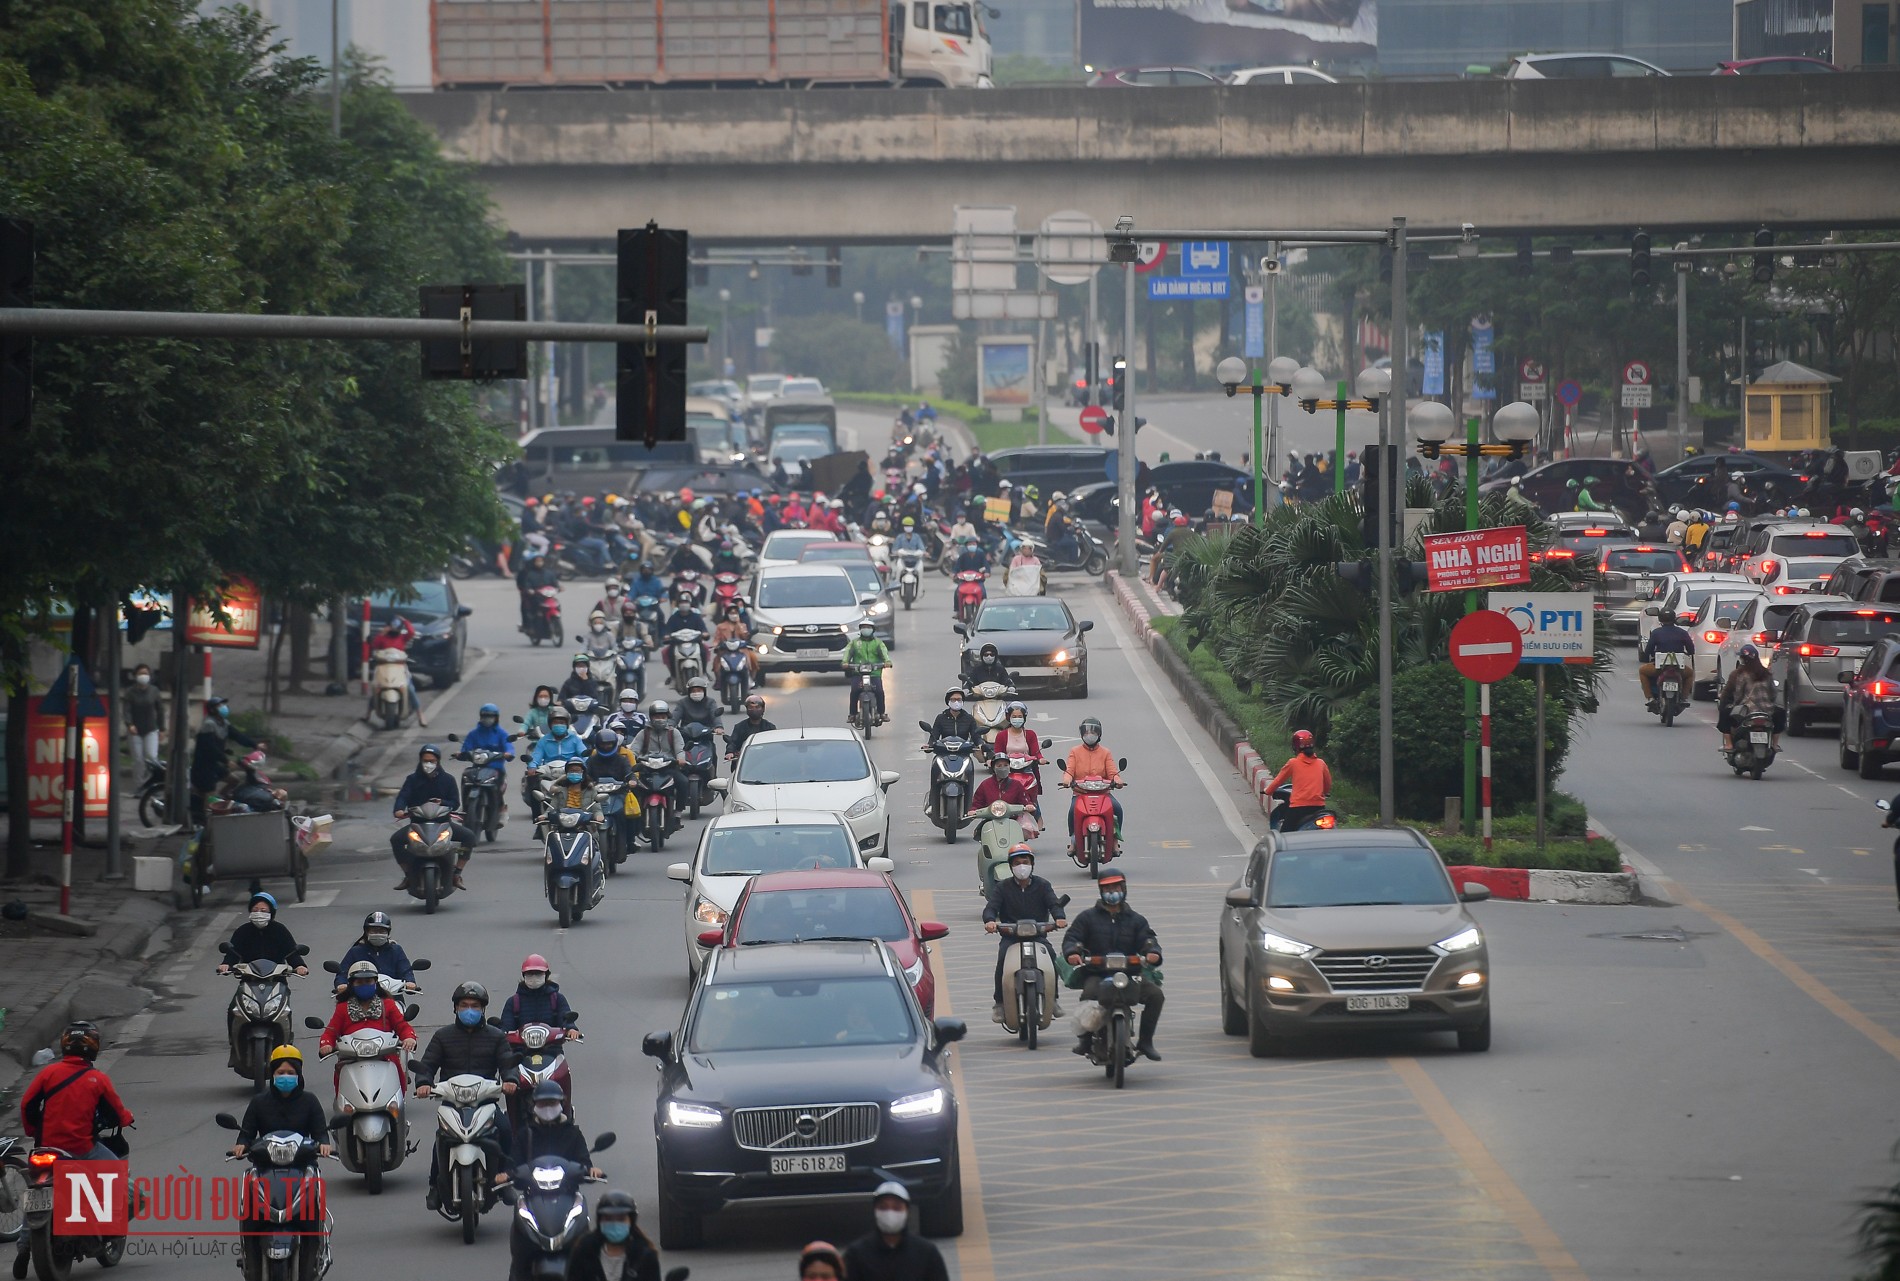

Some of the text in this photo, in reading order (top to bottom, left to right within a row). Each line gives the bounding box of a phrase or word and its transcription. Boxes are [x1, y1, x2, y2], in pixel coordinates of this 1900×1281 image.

[1432, 536, 1522, 569] NHÀ NGHỈ
[1540, 610, 1582, 631] PTI
